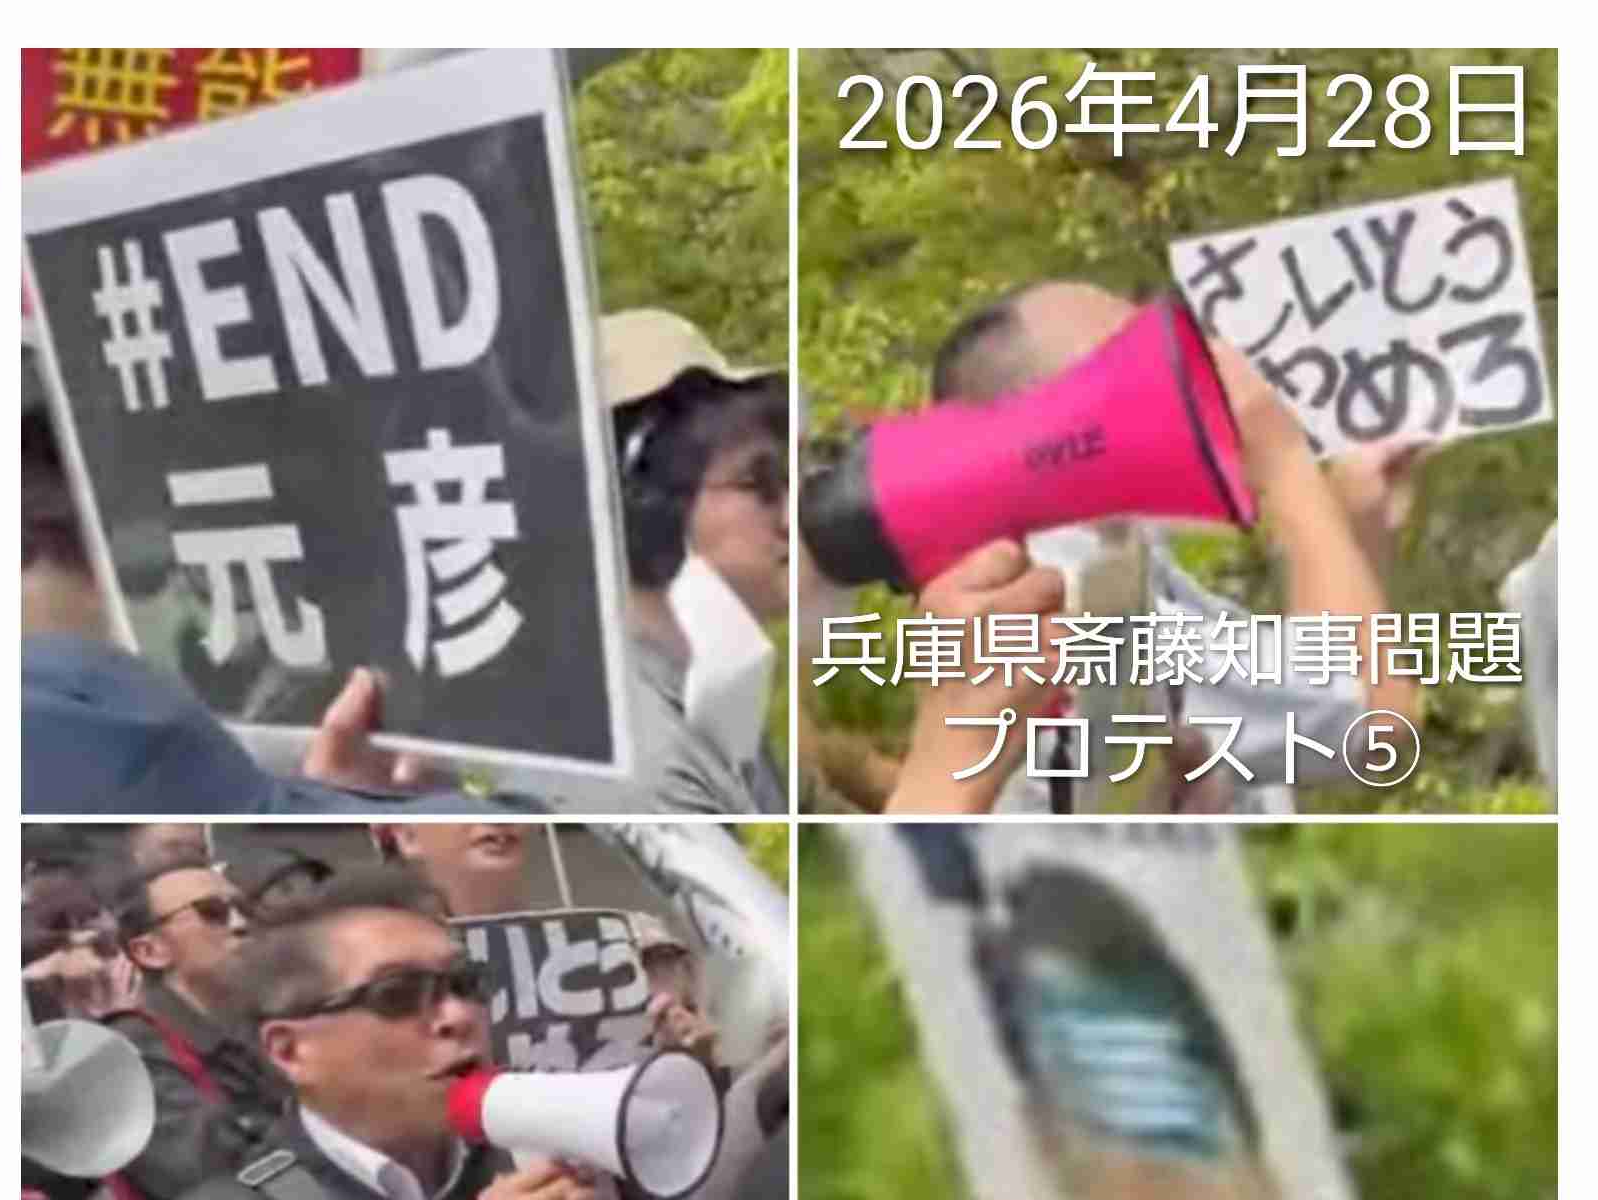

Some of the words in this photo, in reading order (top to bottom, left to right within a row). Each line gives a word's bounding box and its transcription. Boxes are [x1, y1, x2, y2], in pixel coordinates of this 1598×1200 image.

[93, 173, 501, 411] #END
[1188, 198, 1514, 357] さいとう
[1255, 313, 1544, 456] やめろ
[167, 428, 523, 678] 元彦
[466, 916, 651, 1024] いとう
